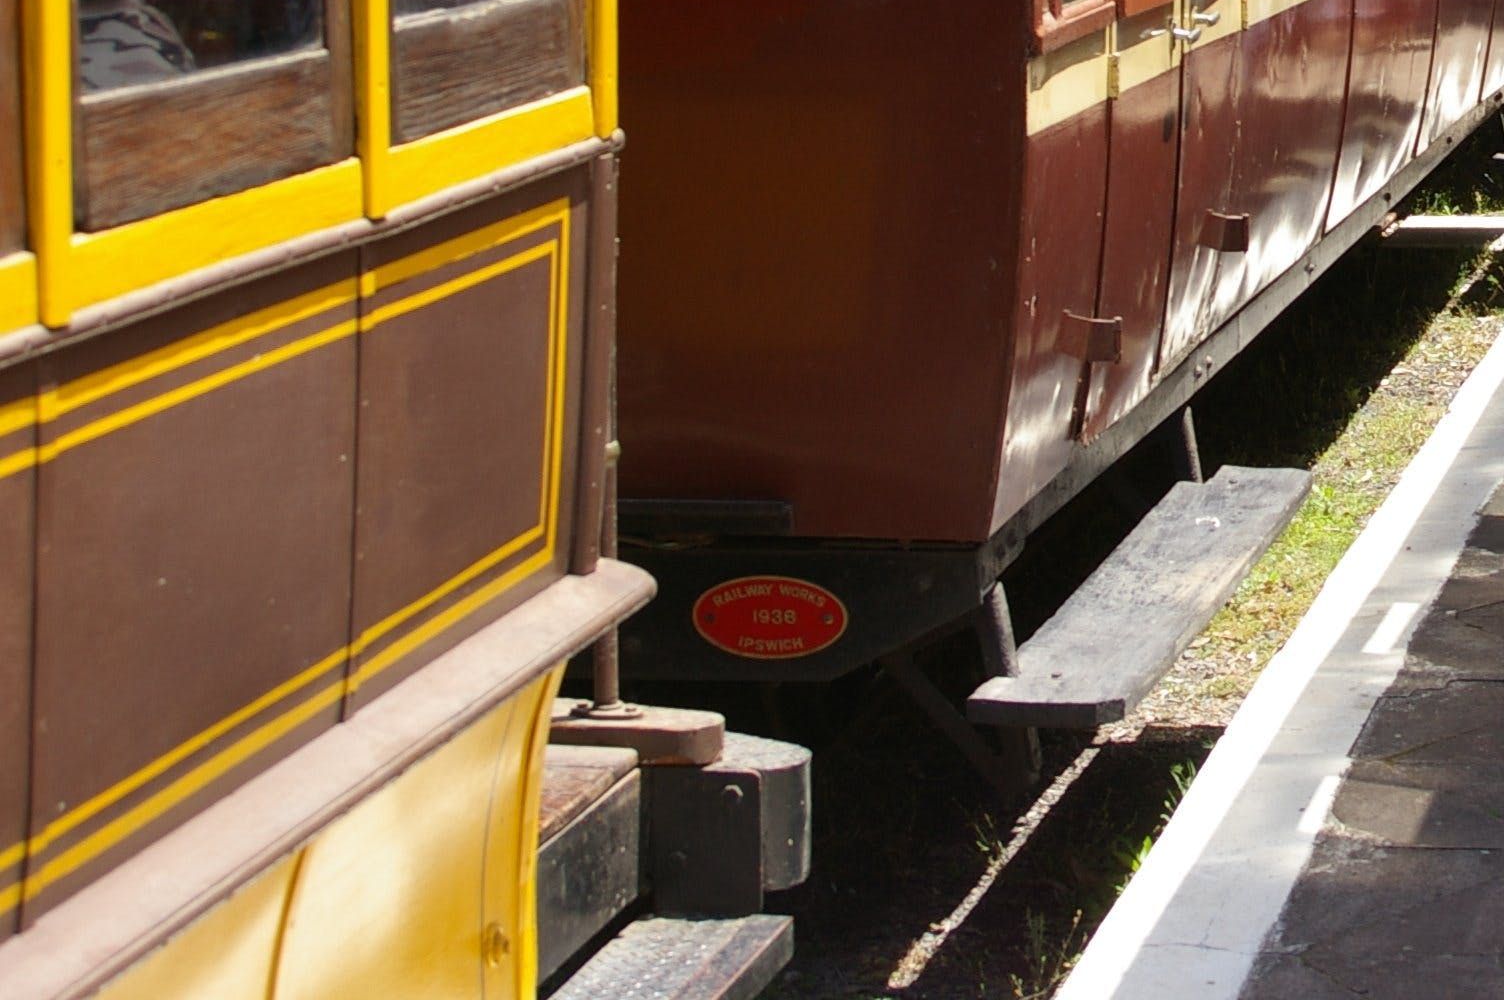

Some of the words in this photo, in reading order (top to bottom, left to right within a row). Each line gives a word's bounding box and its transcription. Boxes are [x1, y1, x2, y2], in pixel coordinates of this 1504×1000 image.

[712, 583, 773, 607] RAILWAY
[779, 584, 826, 607] WORKS
[738, 636, 804, 651] IPSWICH
